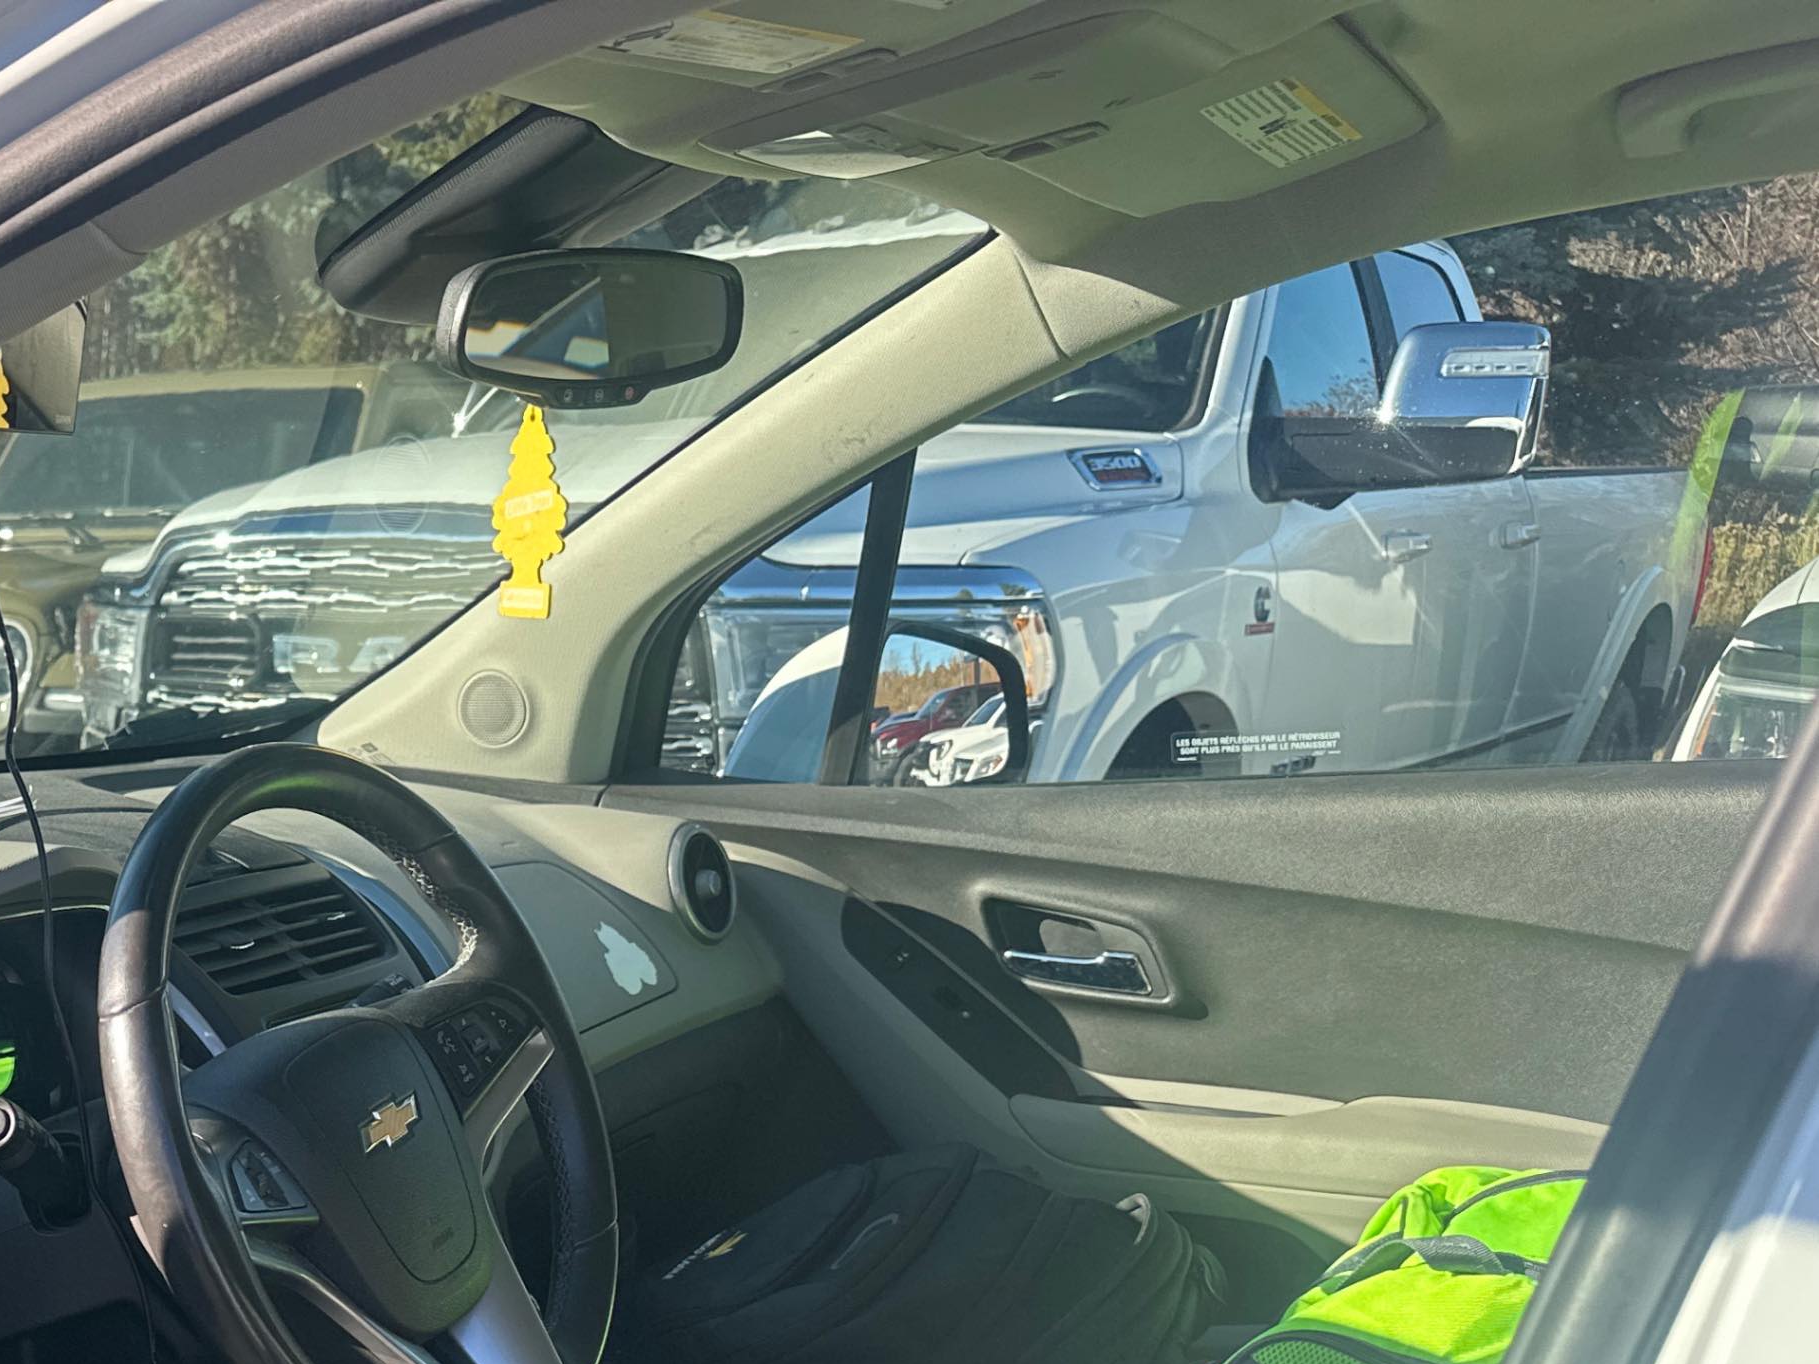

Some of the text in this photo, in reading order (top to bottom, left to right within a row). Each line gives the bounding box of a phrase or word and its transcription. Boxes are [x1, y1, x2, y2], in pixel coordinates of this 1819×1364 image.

[1088, 456, 1142, 471] 3500
[272, 635, 406, 674] RA
[1176, 739, 1190, 748] LES
[1191, 737, 1218, 747] OBJETS
[1261, 733, 1276, 743] PAR
[1278, 733, 1287, 742] LE
[1180, 747, 1199, 755] SONT
[1201, 746, 1219, 754] PLUS
[1268, 742, 1278, 751] NE
[1280, 742, 1289, 750] LE
